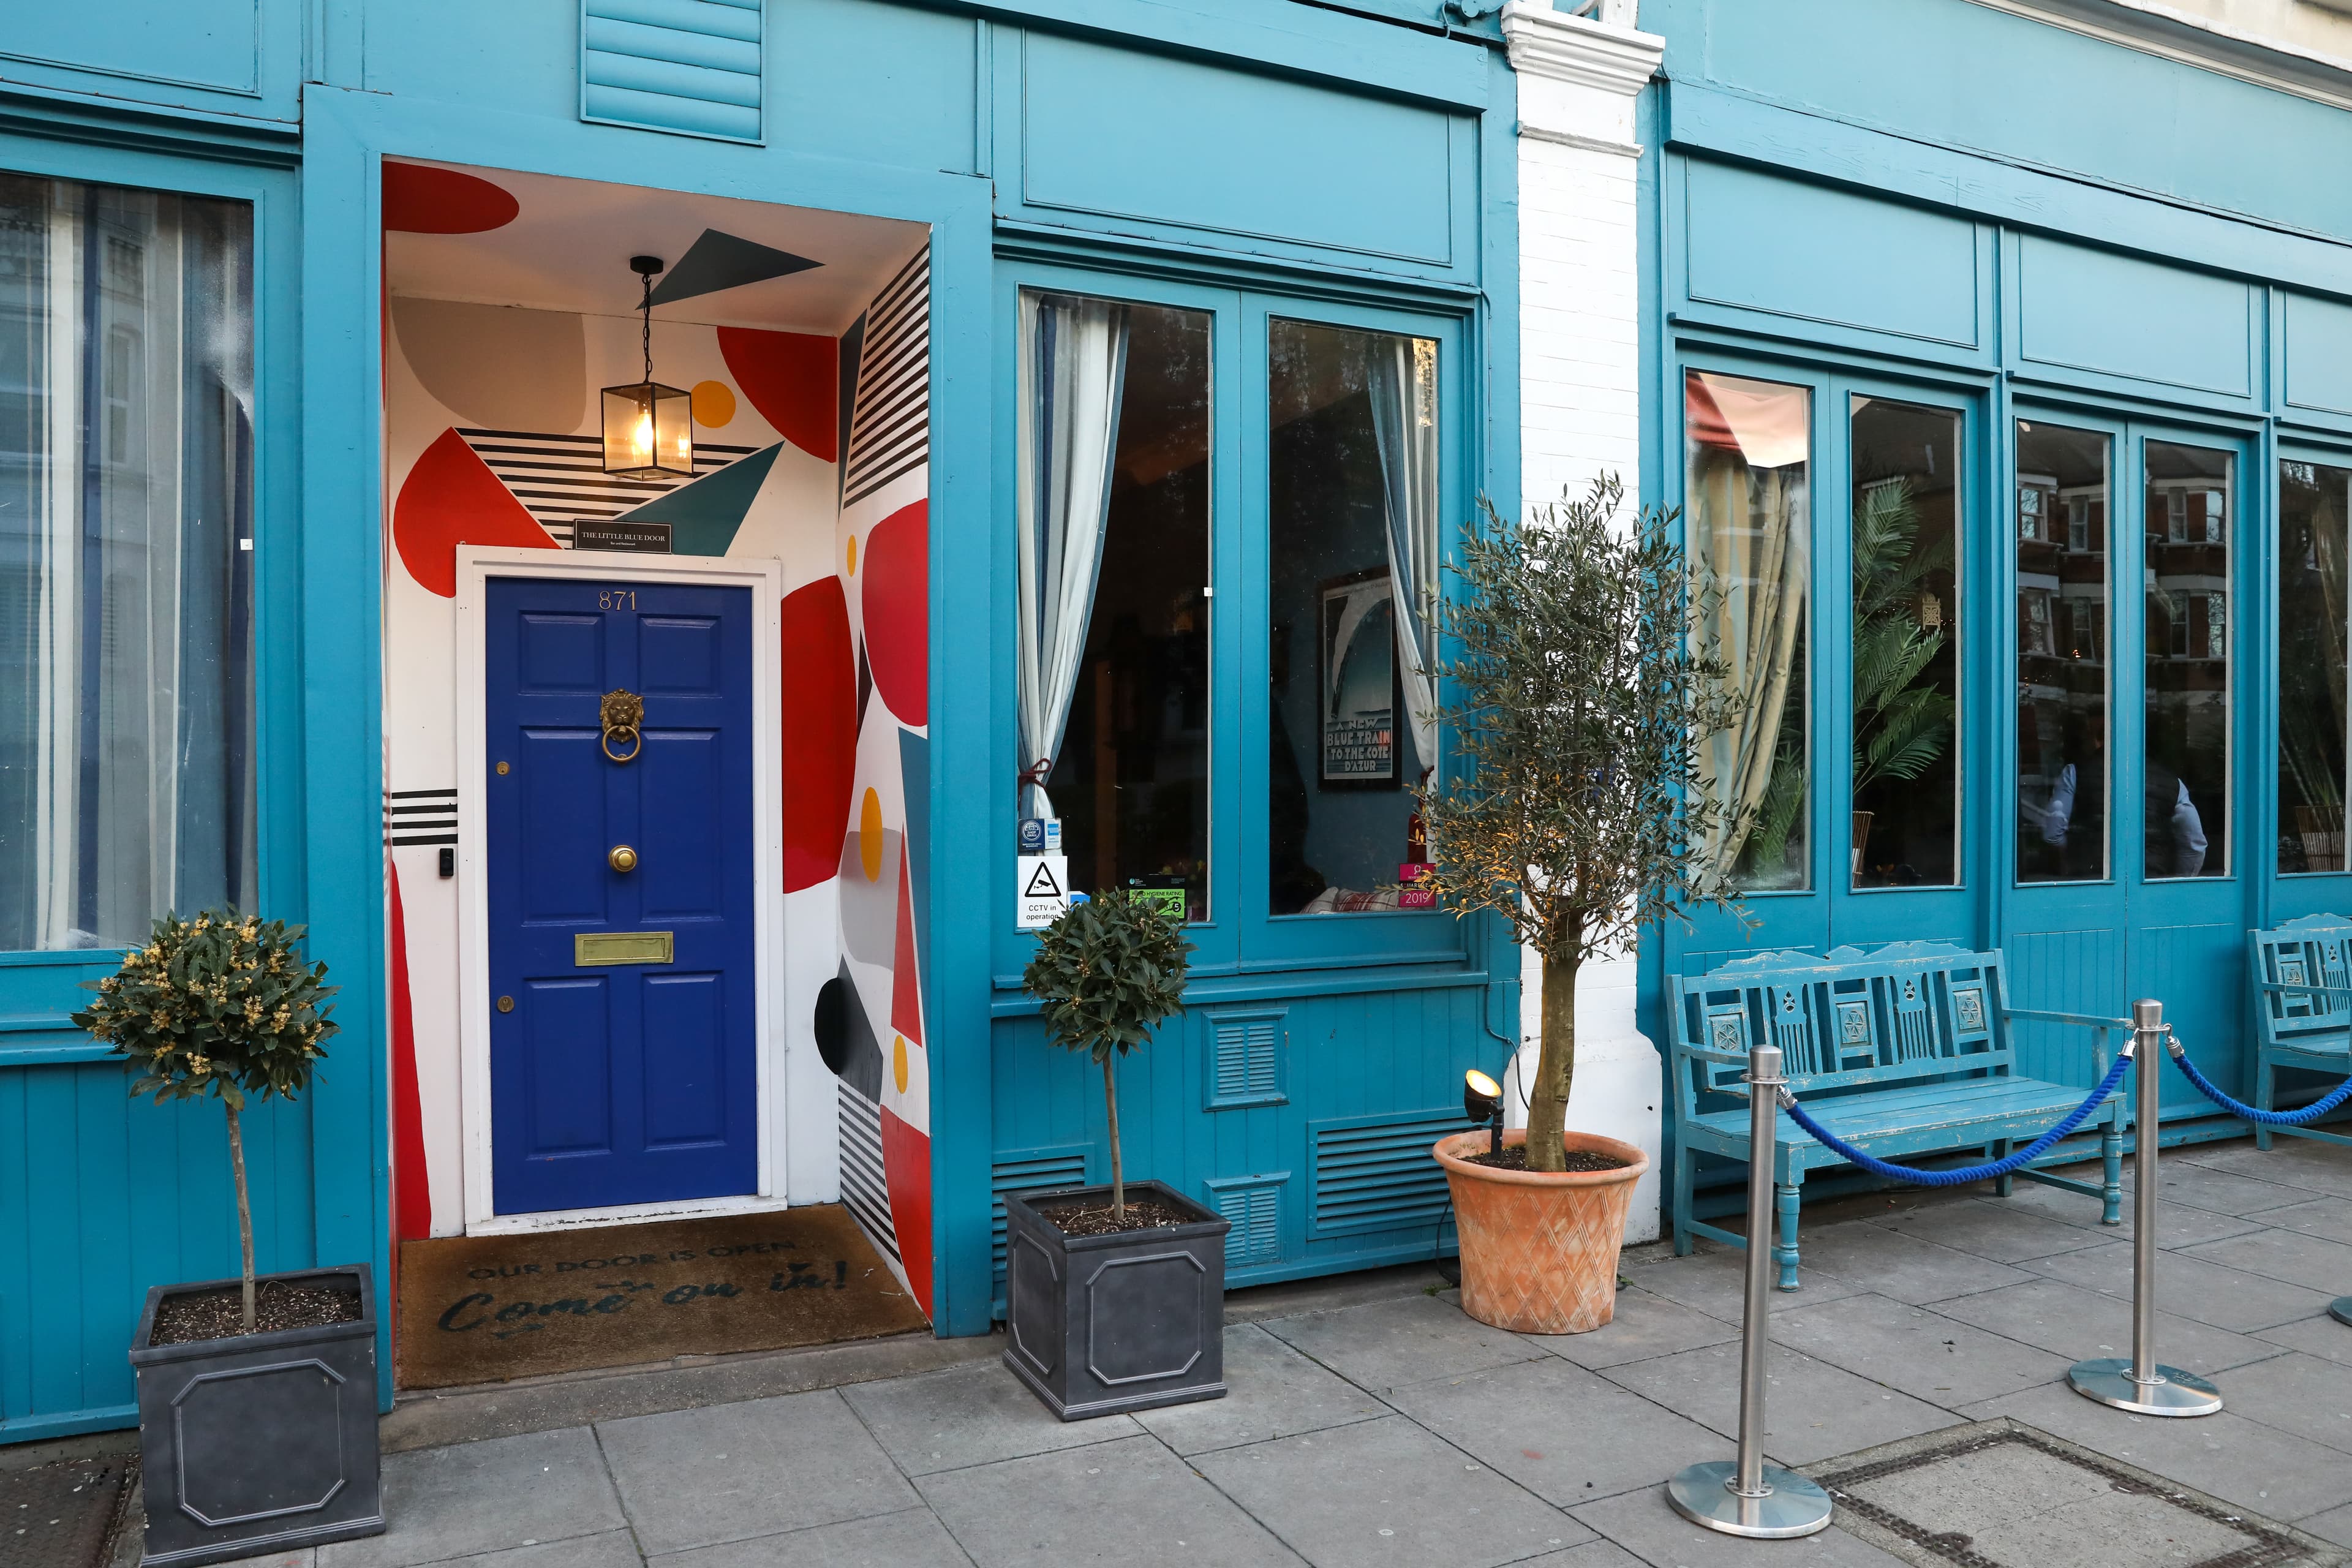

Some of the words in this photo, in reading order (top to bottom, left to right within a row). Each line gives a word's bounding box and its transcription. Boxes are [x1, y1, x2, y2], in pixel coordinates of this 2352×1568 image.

[599, 590, 636, 611] 871
[1349, 718, 1378, 729] NEW
[1327, 731, 1354, 746] BLUE
[1357, 730, 1390, 745] TRAIN
[1331, 748, 1343, 760] TO
[1344, 747, 1364, 760] THE
[1344, 760, 1376, 772] D'AZUR
[1406, 892, 1428, 903] 2019
[468, 1263, 540, 1279] OUR
[556, 1254, 656, 1272] DOOR
[669, 1250, 696, 1261] IS
[707, 1242, 795, 1256] OPEN
[437, 1293, 635, 1332] Come
[662, 1283, 745, 1305] on
